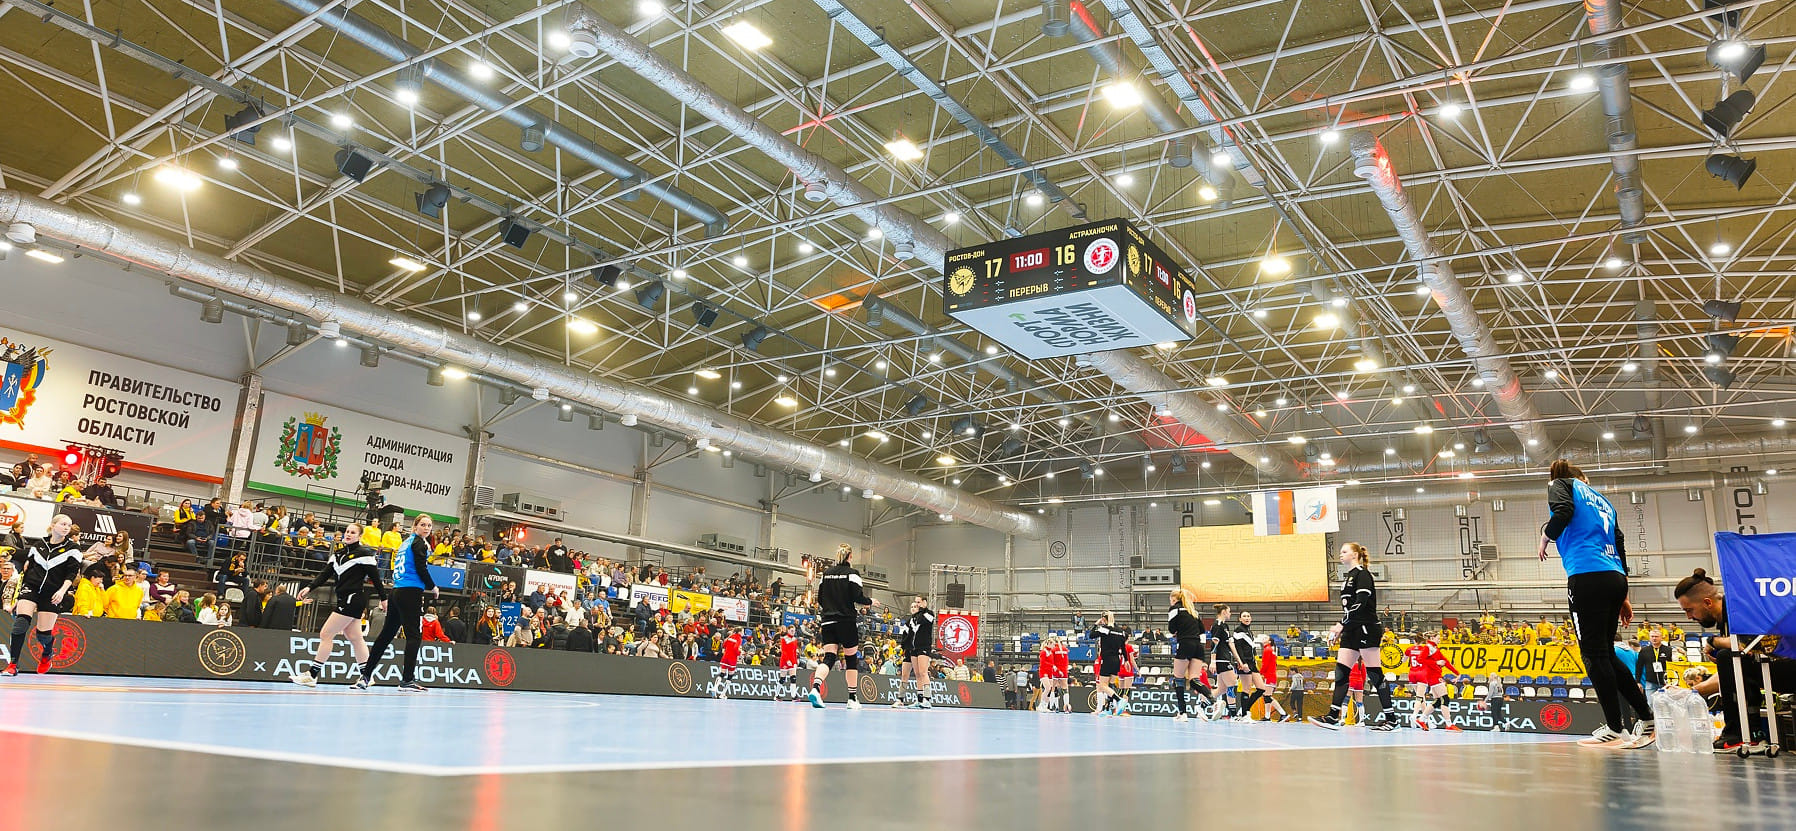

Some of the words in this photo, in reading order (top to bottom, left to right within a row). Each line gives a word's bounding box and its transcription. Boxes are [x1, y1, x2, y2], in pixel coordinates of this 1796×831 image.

[1069, 224, 1118, 239] АСТРАХАНОЧКА
[948, 250, 985, 263] РОСТОВ-ДОН
[984, 257, 1003, 279] 17
[1014, 252, 1043, 269] 11:00
[1055, 244, 1076, 266] 16
[1143, 252, 1153, 275] 17
[1172, 277, 1181, 300] 16
[1009, 283, 1049, 298] ПЕРЕРЫВ
[88, 370, 221, 412] ПРАВИТЕЛЬСТВО
[83, 393, 190, 429] РОСТОВСКОЙ
[77, 418, 156, 446] ОБЛАСТИ
[366, 435, 453, 463] АДМИНИСТРАЦИЯ
[364, 452, 404, 470] ГОРОДА
[451, 571, 461, 586] 2
[1754, 577, 1796, 597] TO
[1086, 648, 1093, 659] 4
